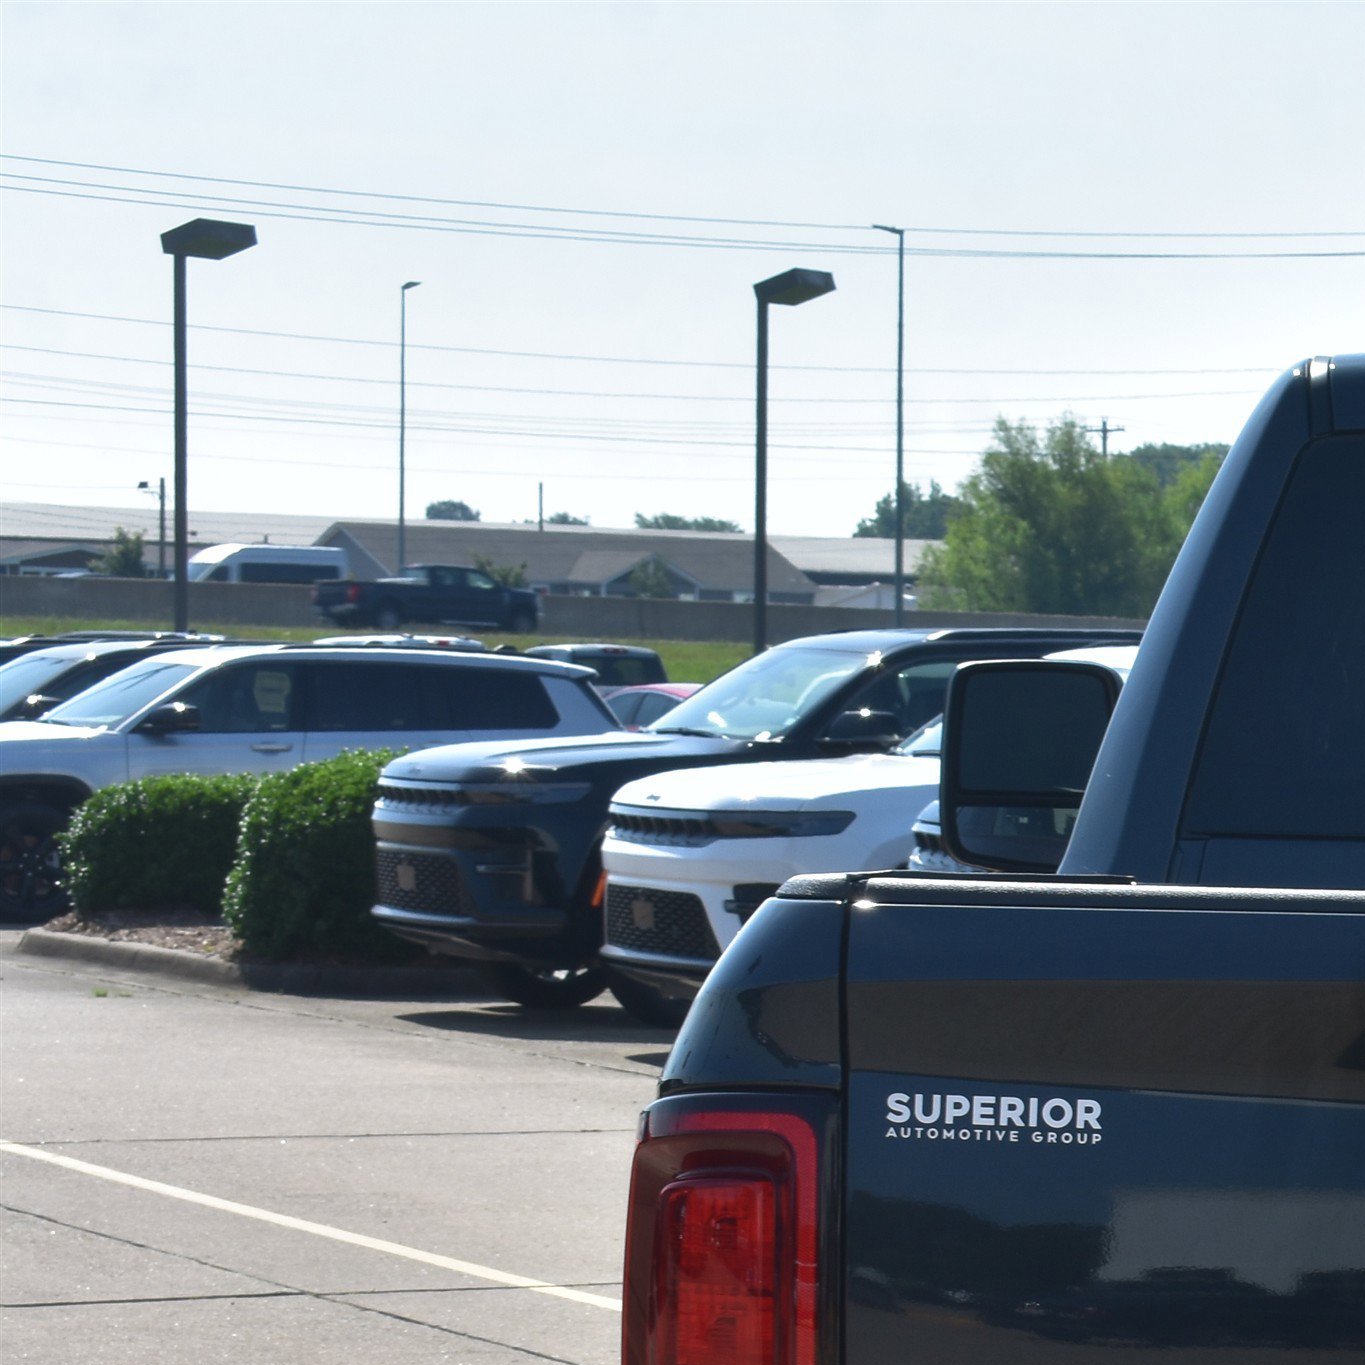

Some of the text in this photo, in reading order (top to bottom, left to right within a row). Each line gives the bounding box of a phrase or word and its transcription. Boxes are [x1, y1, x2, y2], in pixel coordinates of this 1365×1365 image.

[886, 1092, 1102, 1129] SUPERIOR
[885, 1127, 1103, 1145] AUTOMOTIVE GROUP
